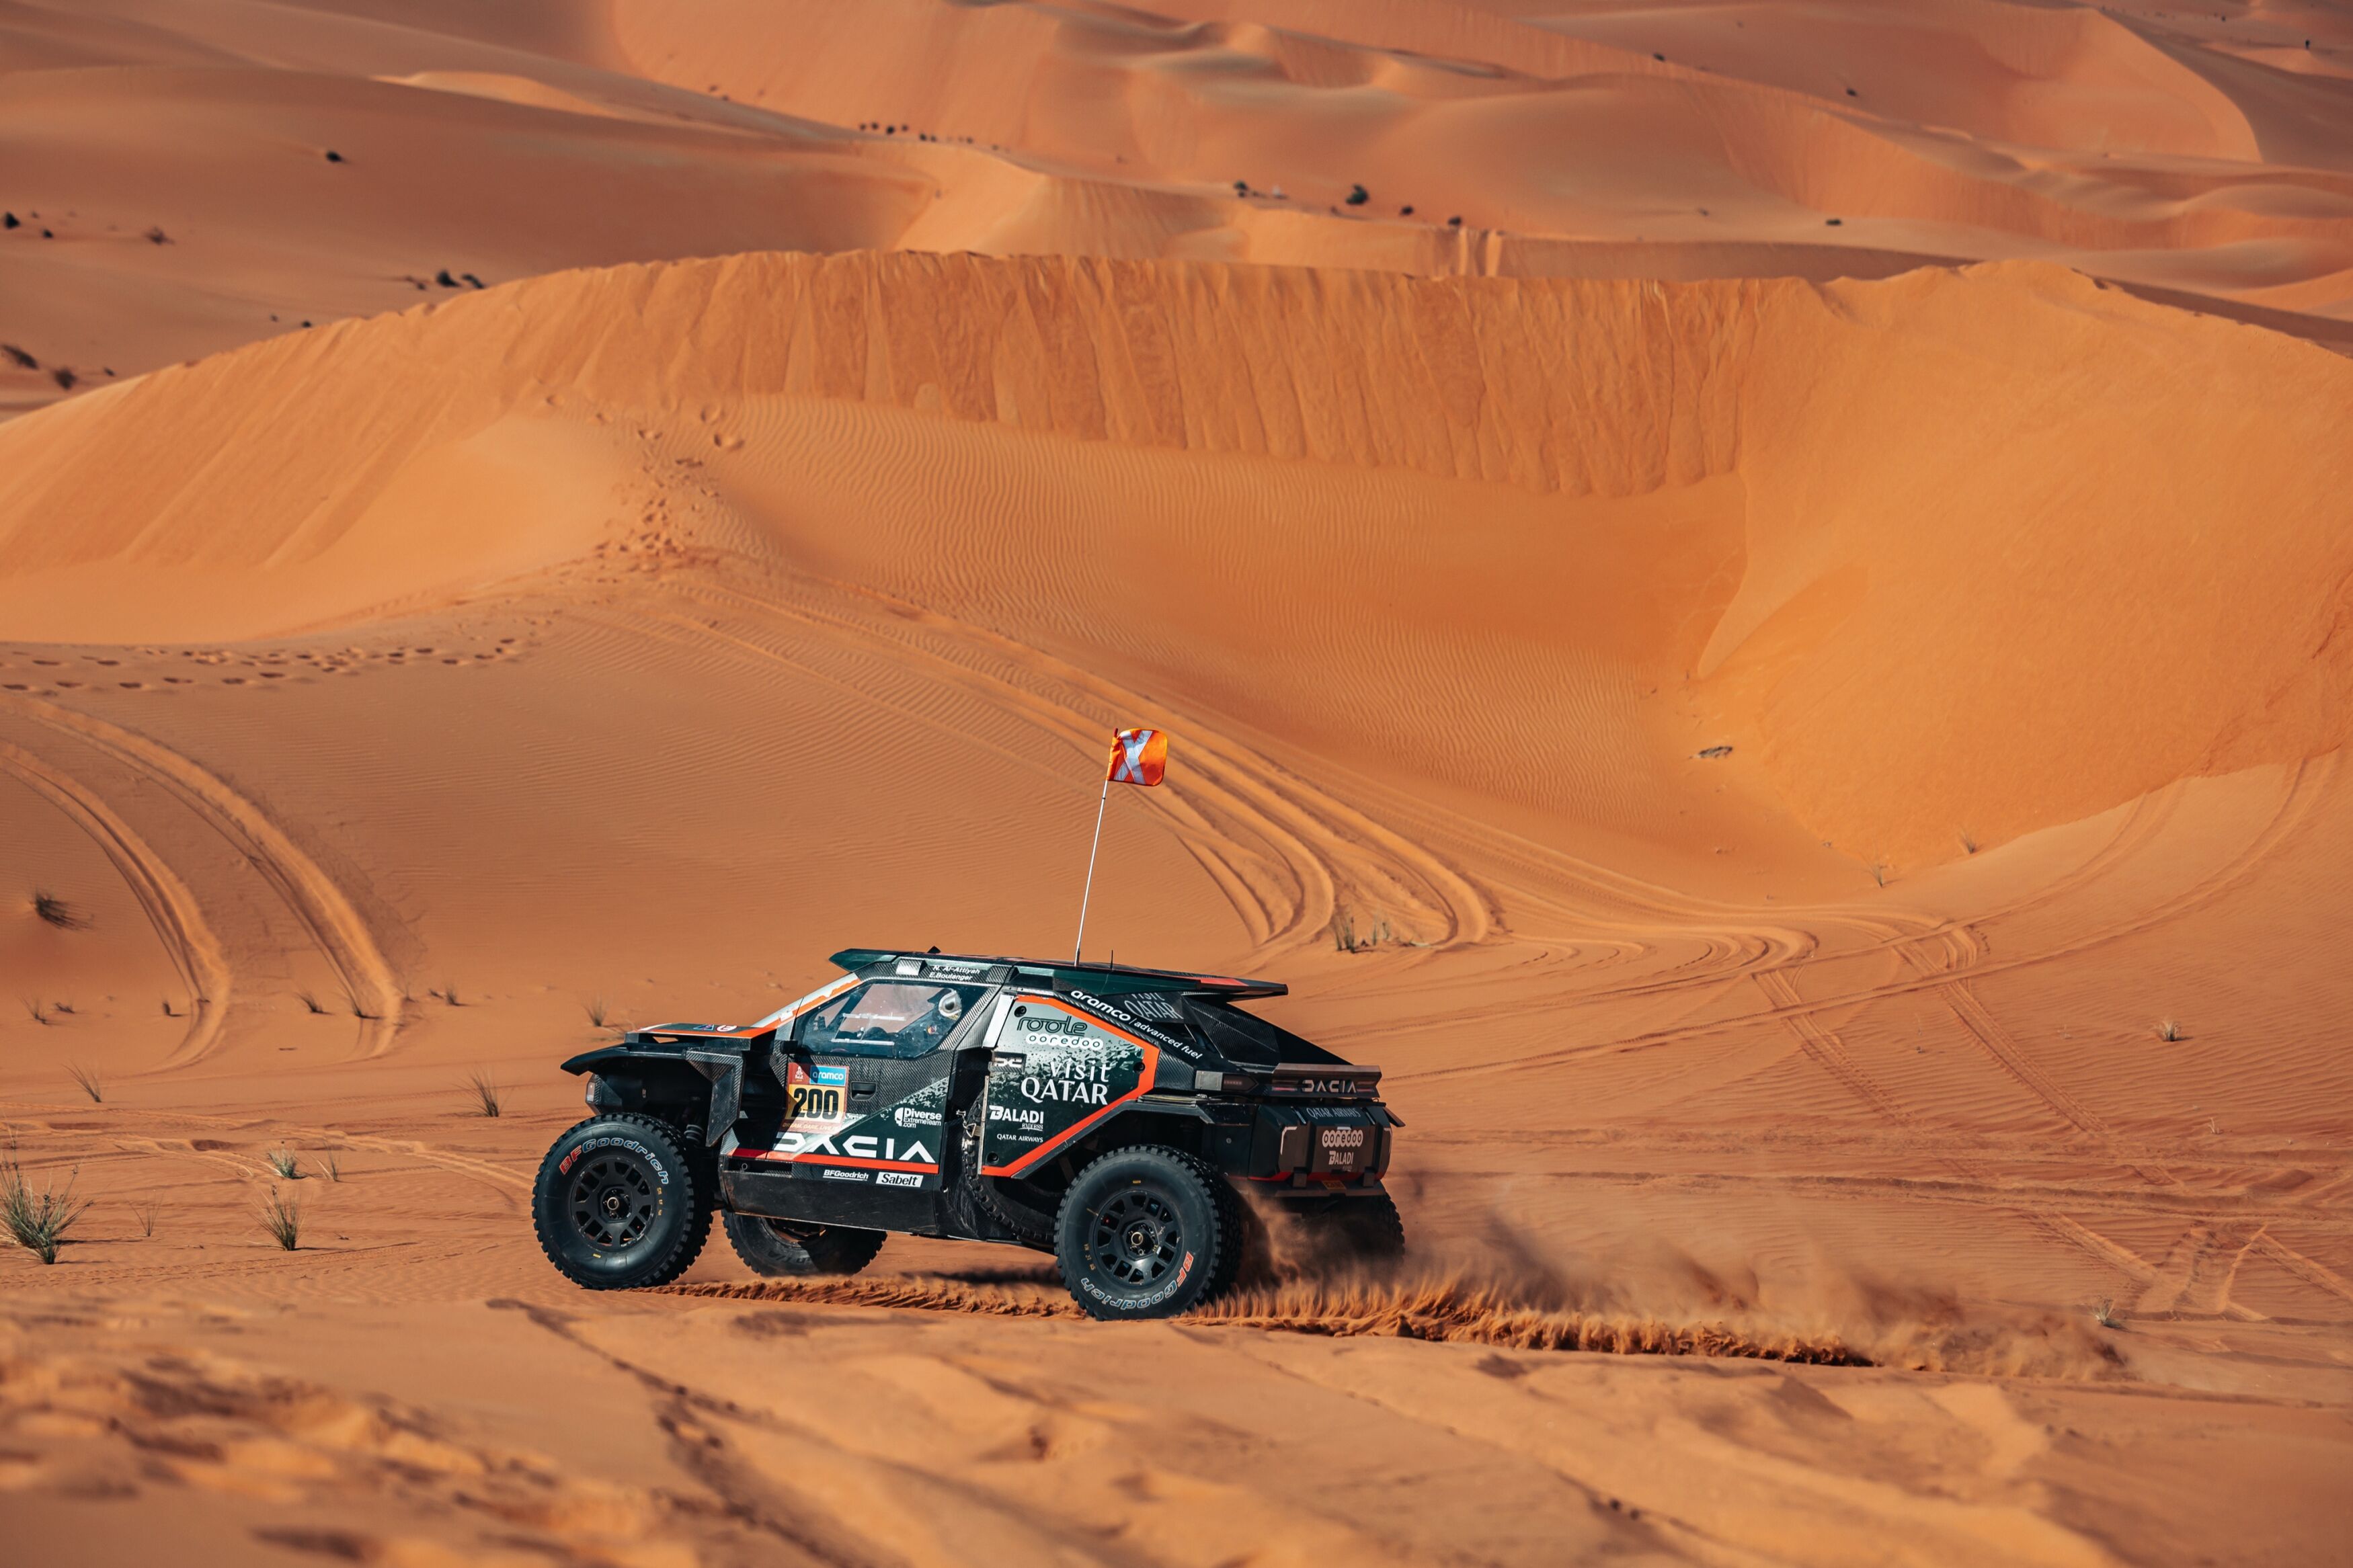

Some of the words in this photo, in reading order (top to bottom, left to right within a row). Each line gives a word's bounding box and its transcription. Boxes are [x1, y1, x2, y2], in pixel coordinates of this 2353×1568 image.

[929, 972, 973, 981] E.Boulanger
[943, 966, 980, 974] Al-Attiyah
[1124, 1000, 1183, 1022] QATAR
[1070, 990, 1131, 1021] aramco
[1133, 1020, 1182, 1048] advanced
[1181, 1046, 1203, 1059] fuel
[1028, 1034, 1101, 1048] ooredoo
[812, 1071, 844, 1080] aramco
[1021, 1077, 1108, 1105] QATAR
[1302, 1079, 1357, 1094] DACIA
[791, 1087, 839, 1120] 200
[904, 1107, 942, 1120] Diverse
[989, 1105, 1044, 1124] BALADI
[1306, 1108, 1333, 1120] QATAR
[904, 1117, 941, 1126] ExtremeTeam
[1022, 1122, 1043, 1131] express
[1323, 1130, 1362, 1146] ooredoo
[774, 1132, 936, 1163] DACIA
[559, 1137, 669, 1184] BFGoodrich
[1328, 1151, 1354, 1165] BALADI
[824, 1169, 869, 1180] BFGoodrich
[881, 1173, 918, 1186] Sabelt
[1081, 1251, 1194, 1311] BFGoodrich
